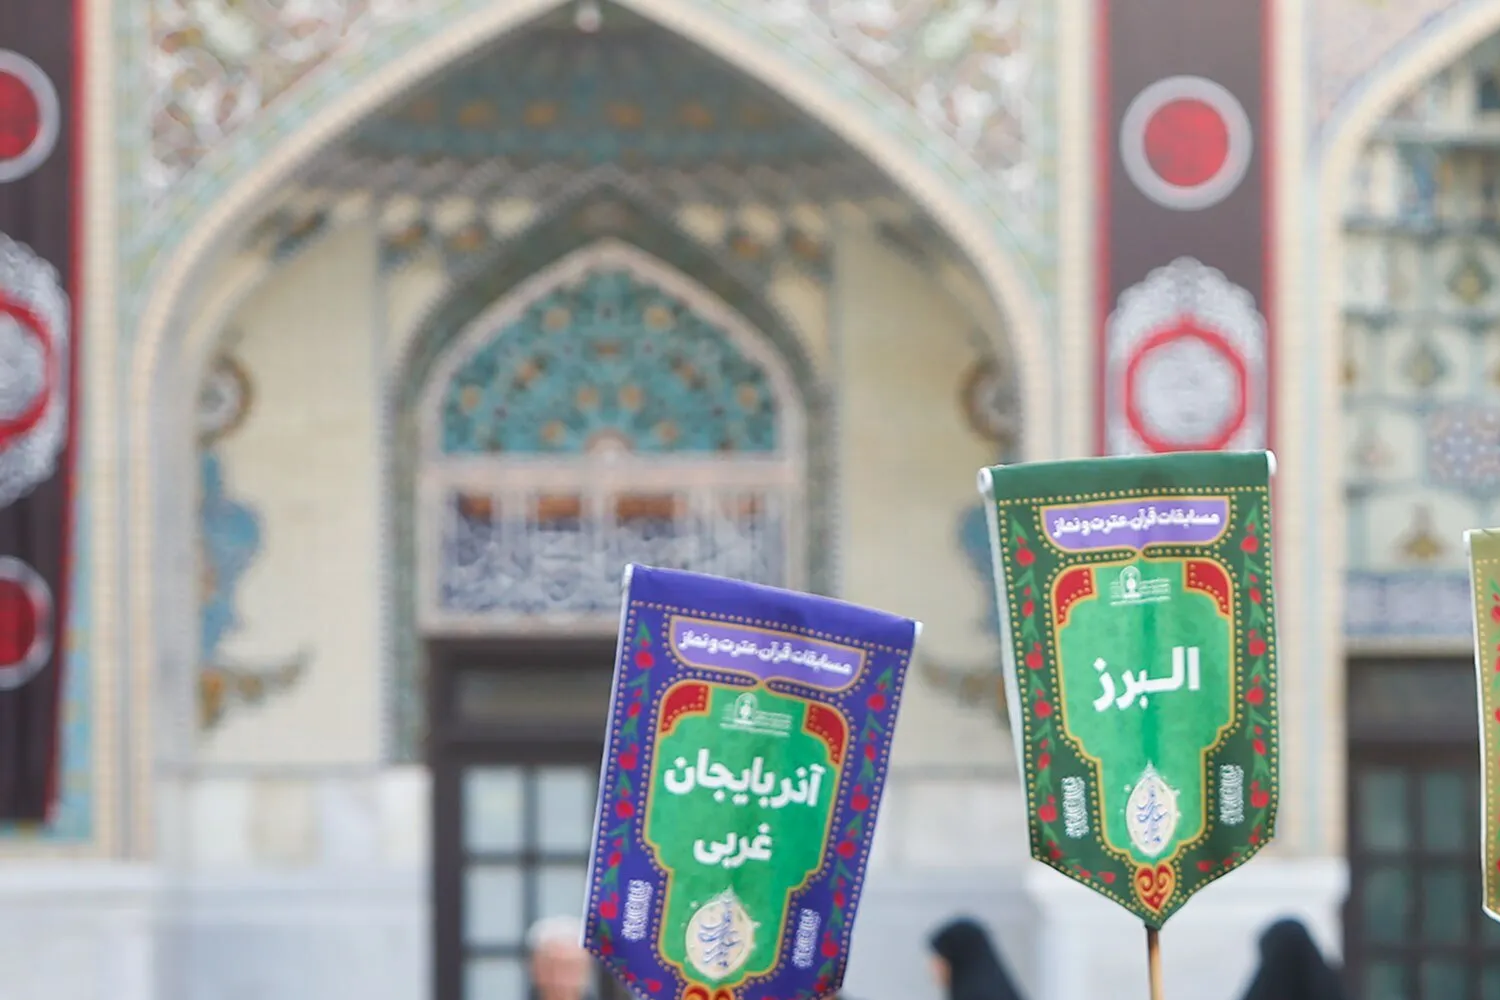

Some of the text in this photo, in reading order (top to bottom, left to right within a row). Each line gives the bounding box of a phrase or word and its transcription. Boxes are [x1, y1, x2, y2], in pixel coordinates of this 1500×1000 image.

[1052, 517, 1081, 538] نماز
[1081, 520, 1091, 536] و
[1090, 514, 1128, 535] عترت
[1157, 508, 1220, 529] مسابقات
[678, 629, 709, 651] نماز
[707, 637, 718, 654] و
[719, 638, 757, 658] عترت
[791, 649, 853, 676] مسابقات
[1092, 645, 1201, 712] البرز
[663, 748, 827, 808] آذربایجان
[693, 822, 773, 869] غربی
